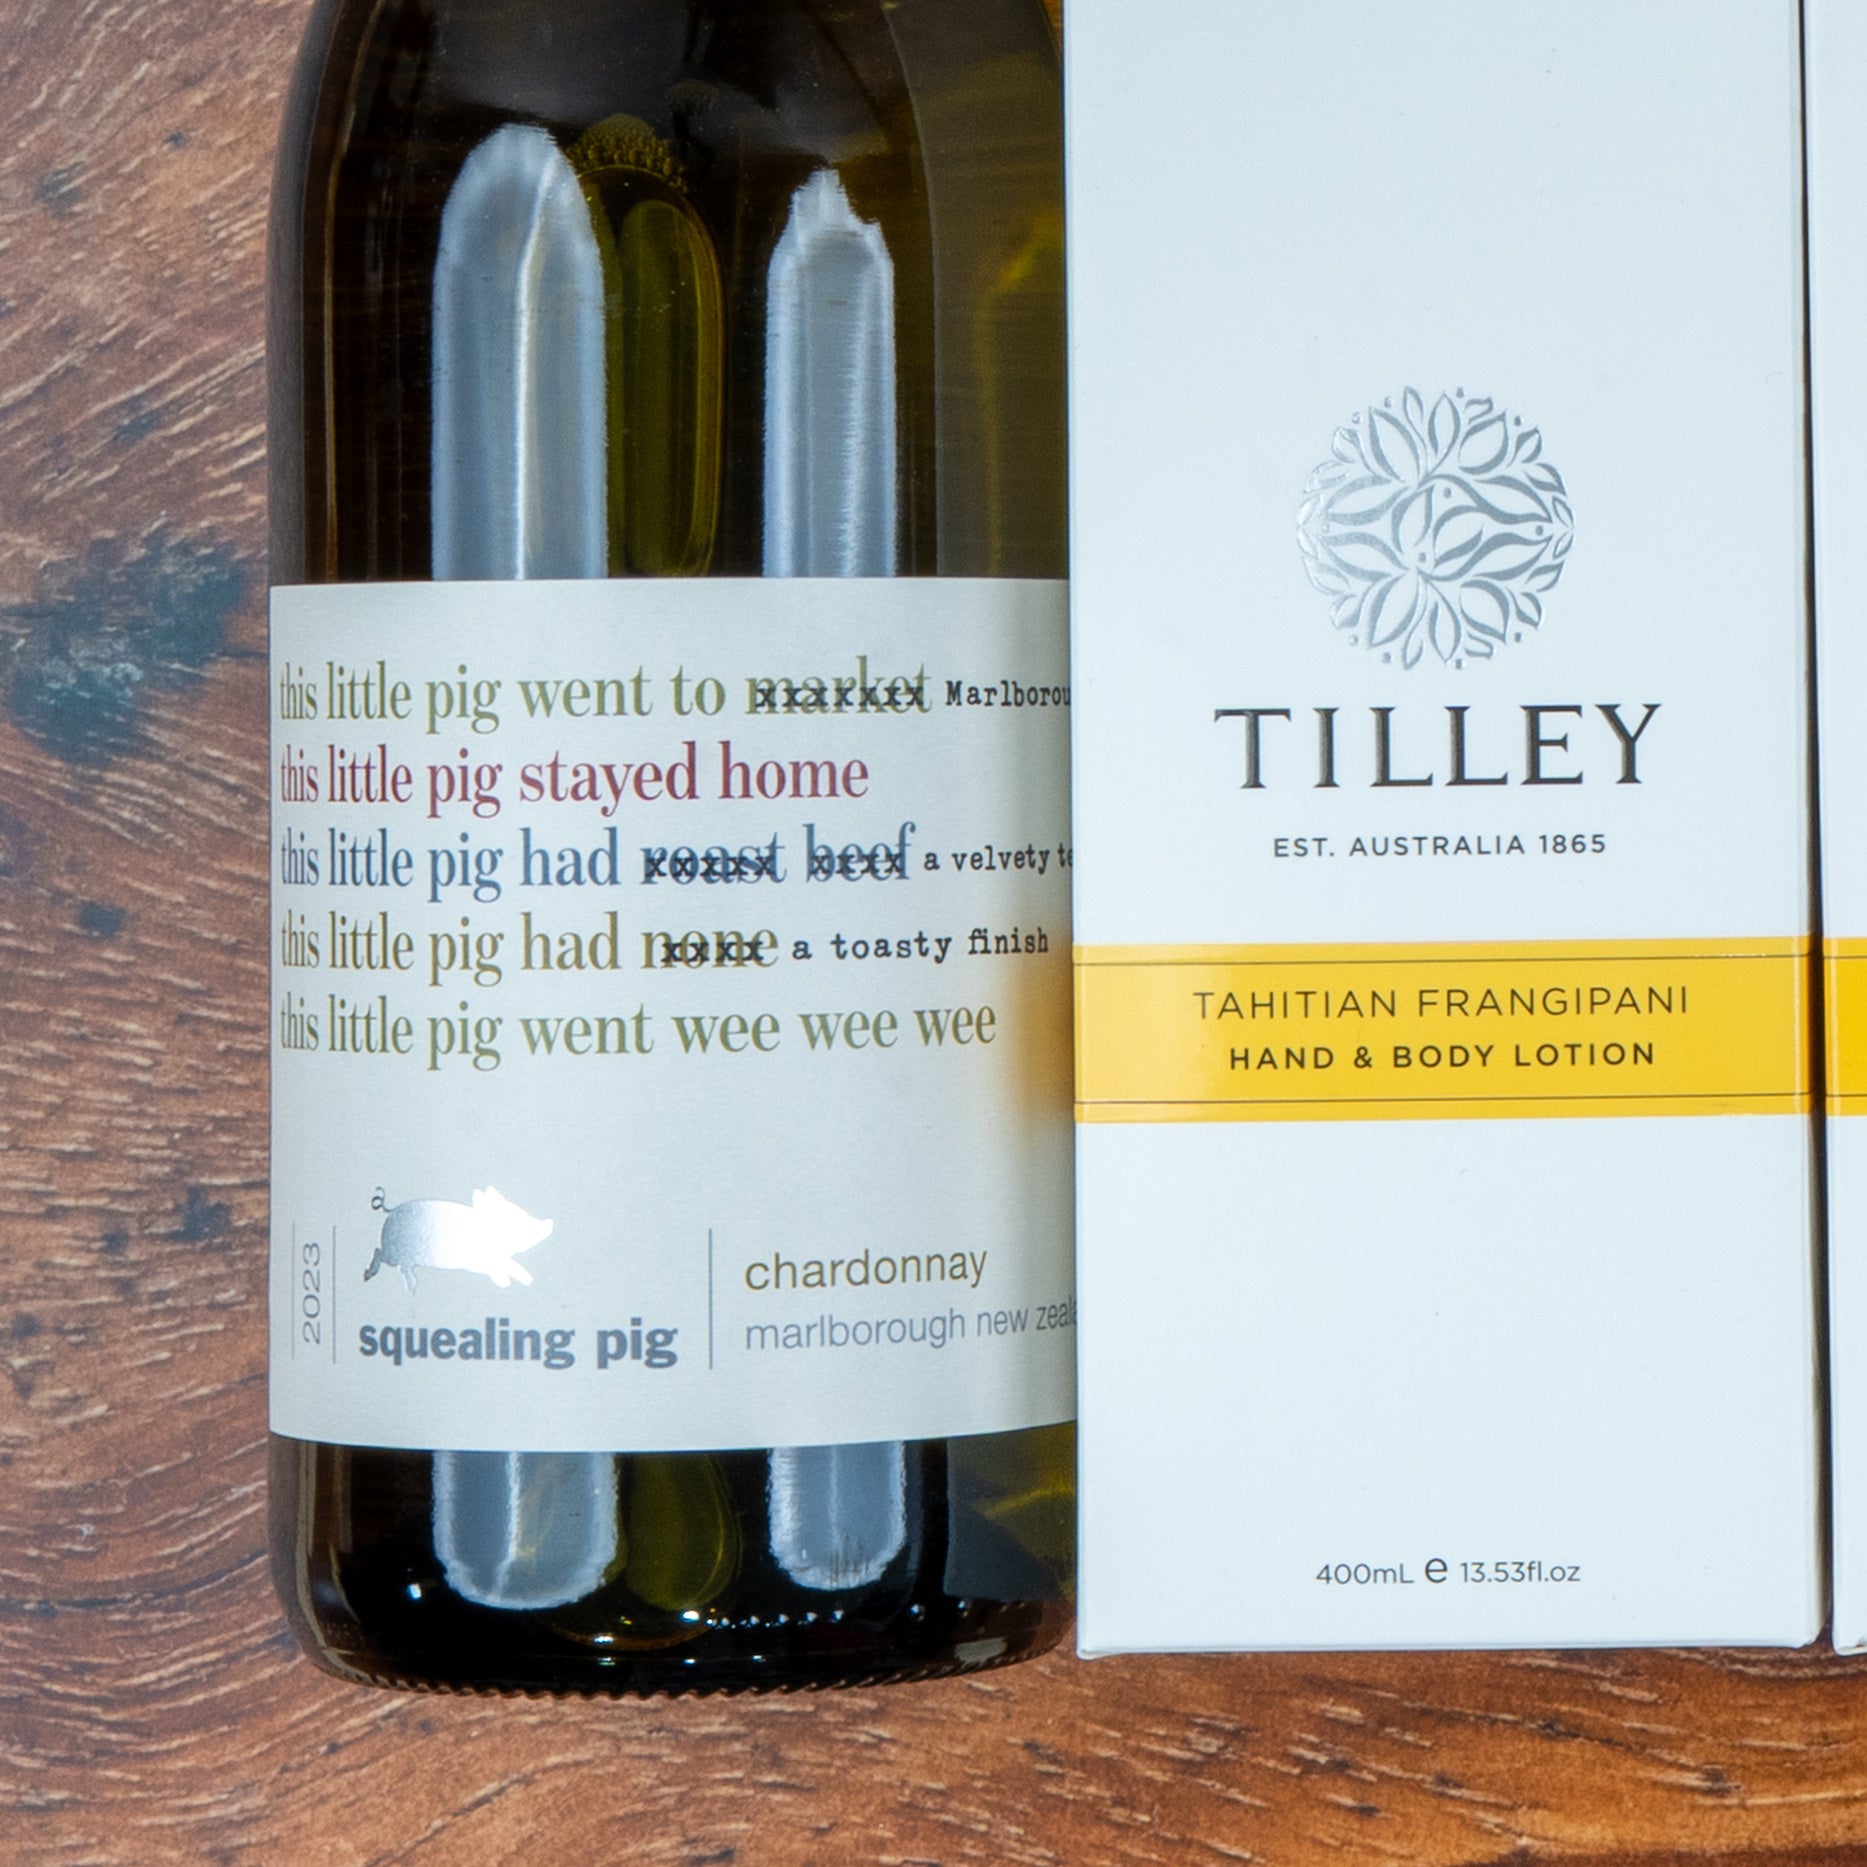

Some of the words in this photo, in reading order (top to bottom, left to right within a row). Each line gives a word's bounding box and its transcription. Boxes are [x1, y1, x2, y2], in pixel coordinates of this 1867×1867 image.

[280, 662, 318, 720] this
[326, 660, 412, 720] little
[425, 664, 502, 735] pig
[517, 665, 653, 718] went
[669, 665, 726, 716] to
[1214, 702, 1662, 788] TILLEY
[281, 744, 319, 802] this
[327, 743, 413, 802] little
[426, 748, 503, 818] pig
[519, 741, 700, 818] stayed
[718, 740, 868, 799] home
[281, 827, 319, 886] this
[328, 827, 414, 887] little
[427, 832, 504, 902] pig
[519, 826, 622, 887] had
[923, 851, 940, 871] a
[951, 843, 1050, 875] velvety
[1273, 837, 1335, 858] EST.
[1349, 835, 1525, 857] AUSTRALIA
[1538, 833, 1606, 854] 1865
[281, 909, 320, 968] this
[328, 910, 414, 970] little
[427, 916, 504, 987] pig
[520, 910, 622, 971] had
[791, 940, 812, 961] a
[830, 932, 952, 964] toasty
[967, 927, 1048, 956] finish
[281, 991, 319, 1051] this
[327, 993, 413, 1054] little
[426, 1000, 503, 1071] pig
[517, 1003, 654, 1055] went
[670, 1011, 780, 1055] wee
[797, 1009, 898, 1051] wee
[912, 1005, 996, 1047] wee
[1193, 990, 1397, 1020] TAHITIAN
[1418, 986, 1688, 1017] FRANGIPANI
[1230, 1046, 1334, 1070] HAND
[1353, 1045, 1373, 1068] &
[1393, 1044, 1494, 1067] BODY
[1515, 1043, 1656, 1066] LOTION
[301, 1241, 321, 1345] 2023
[745, 1248, 987, 1290] chardonnay
[358, 1317, 576, 1370] squealing
[596, 1317, 679, 1370] pig
[745, 1307, 967, 1349] marlborough
[976, 1306, 1029, 1337] new
[1316, 1563, 1414, 1585] 400mL
[1460, 1561, 1581, 1583] 13.53fl.oz
